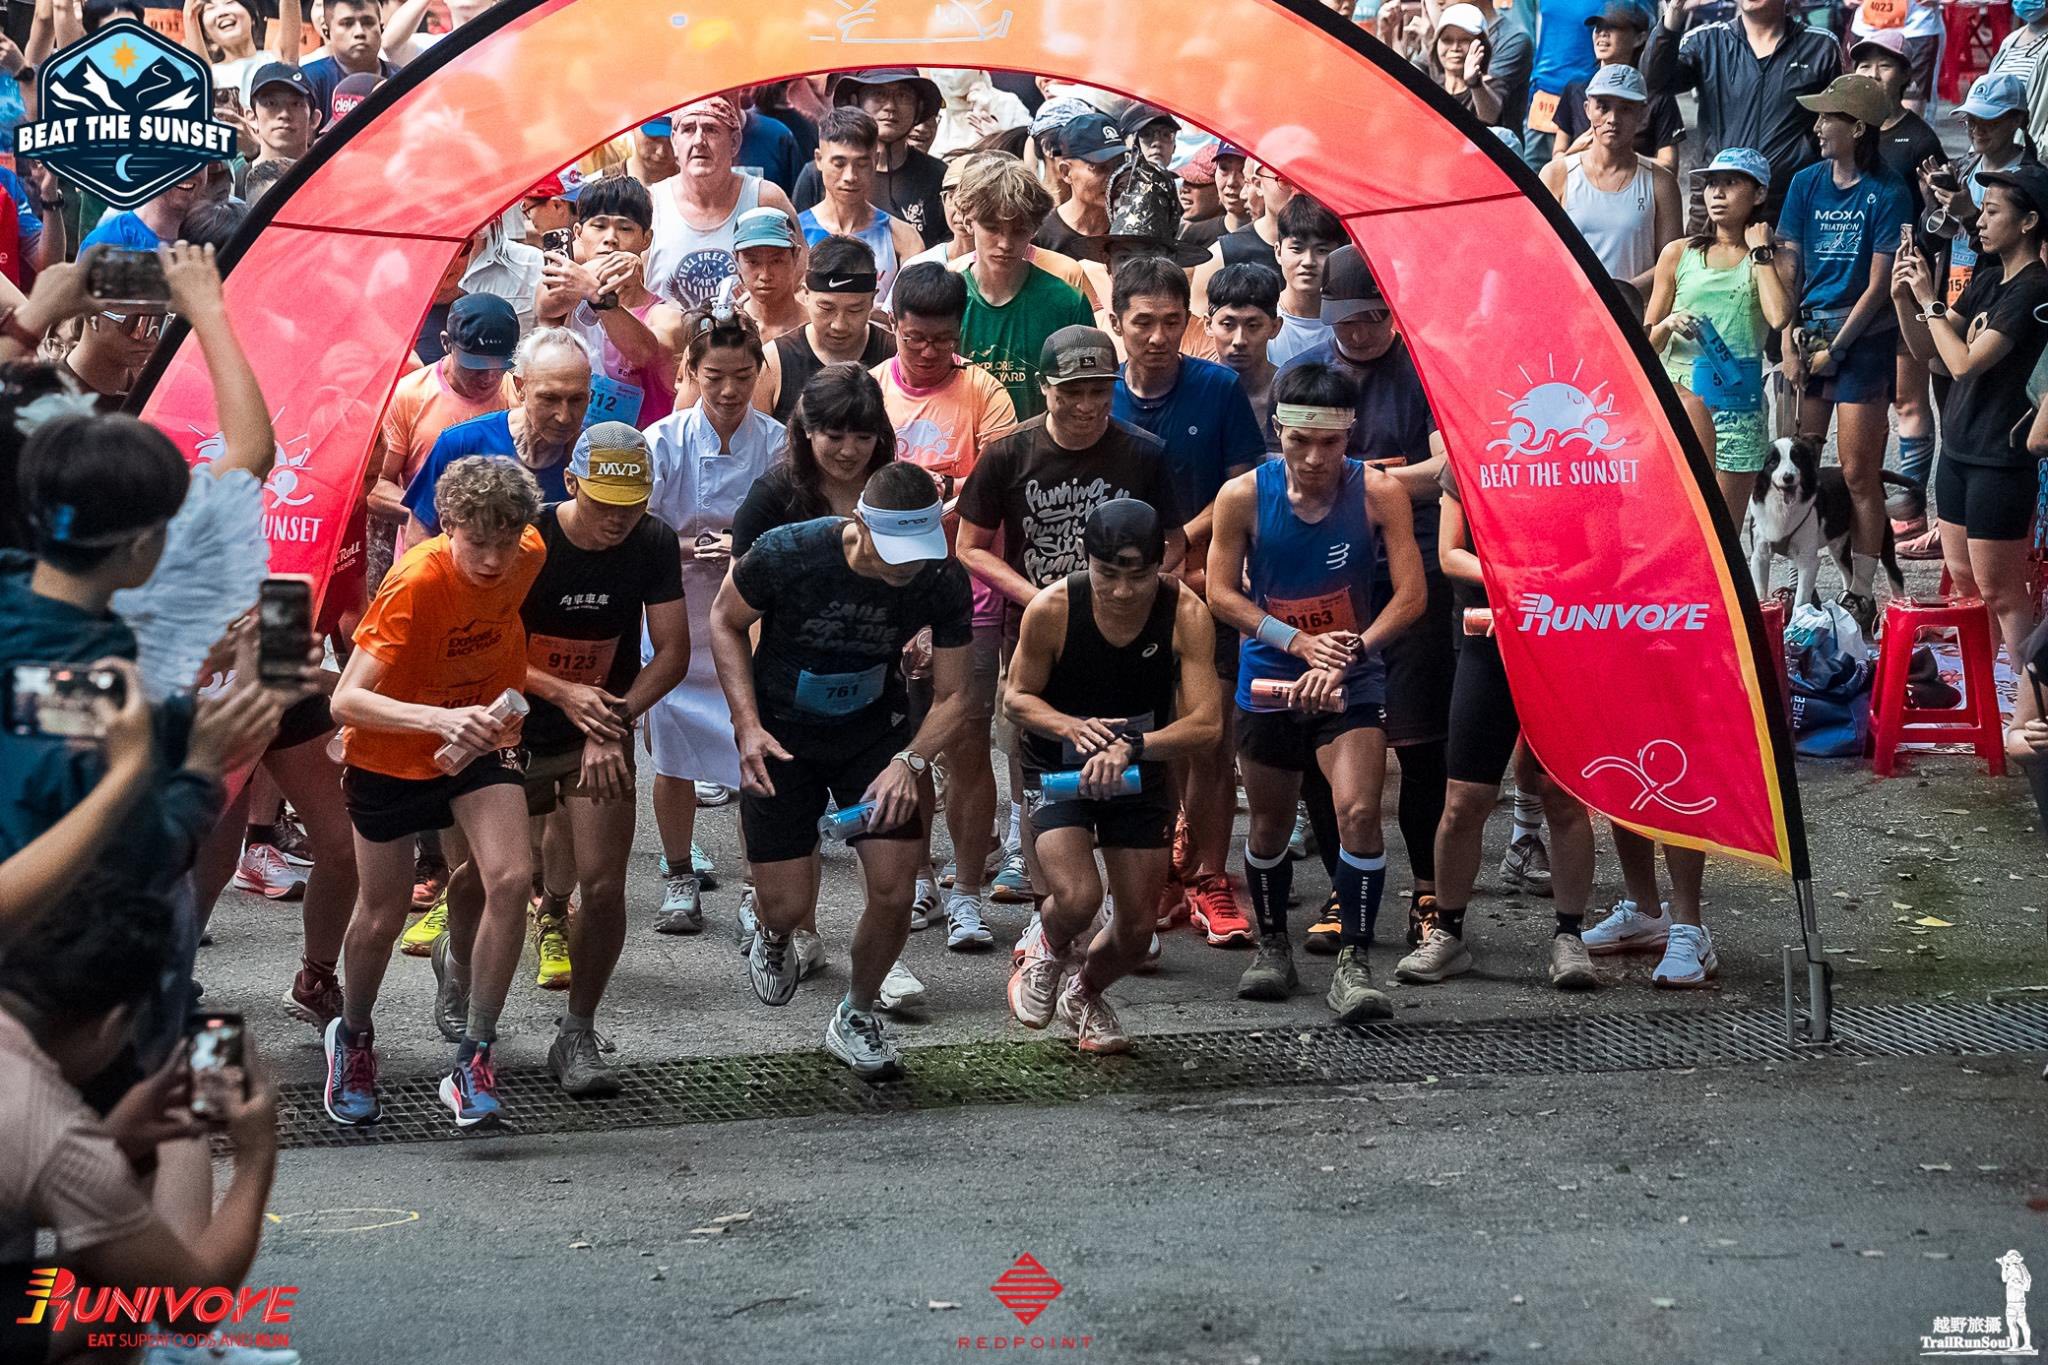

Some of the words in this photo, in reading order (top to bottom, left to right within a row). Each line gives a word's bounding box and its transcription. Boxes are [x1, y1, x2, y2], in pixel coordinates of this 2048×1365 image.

[679, 257, 697, 278] FEEL
[698, 252, 726, 263] FREE
[724, 258, 737, 273] TO
[596, 462, 641, 477] MVP
[1479, 463, 1520, 489] BEAT
[1526, 462, 1562, 487] THE
[1568, 459, 1639, 485] SUNSET
[260, 514, 324, 543] UNSET
[1287, 610, 1334, 631] 9163
[548, 652, 598, 670] 9123
[825, 684, 860, 699] 761
